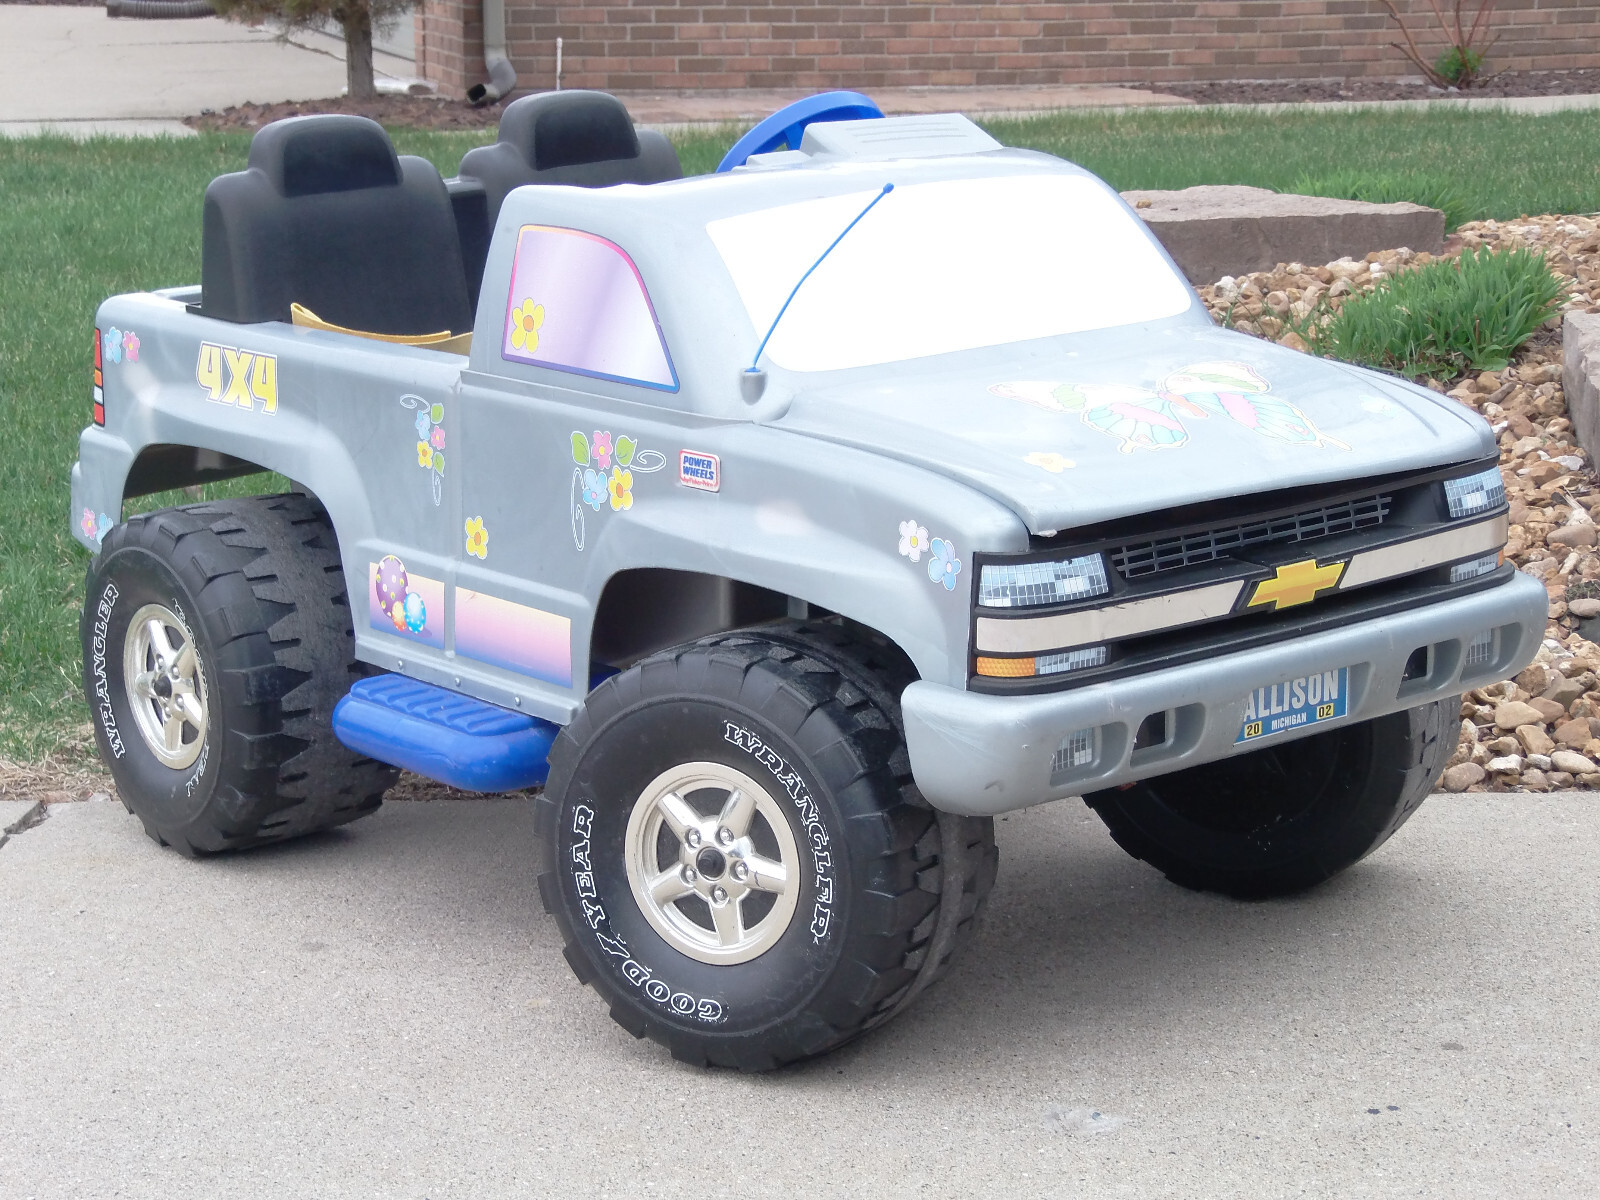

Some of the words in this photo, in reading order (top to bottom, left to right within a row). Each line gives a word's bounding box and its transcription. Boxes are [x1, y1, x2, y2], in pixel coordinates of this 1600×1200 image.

[196, 341, 278, 415] 4X4
[682, 465, 714, 480] WHEELS
[683, 455, 712, 470] POWER
[93, 583, 125, 759] WRANGLER
[1243, 669, 1339, 722] ALLISON
[1246, 723, 1260, 737] 20
[1271, 712, 1307, 731] MICHIGAN
[1318, 704, 1332, 718] 02
[724, 722, 833, 938] WRANGLER
[572, 804, 722, 1020] GOODYEAR
